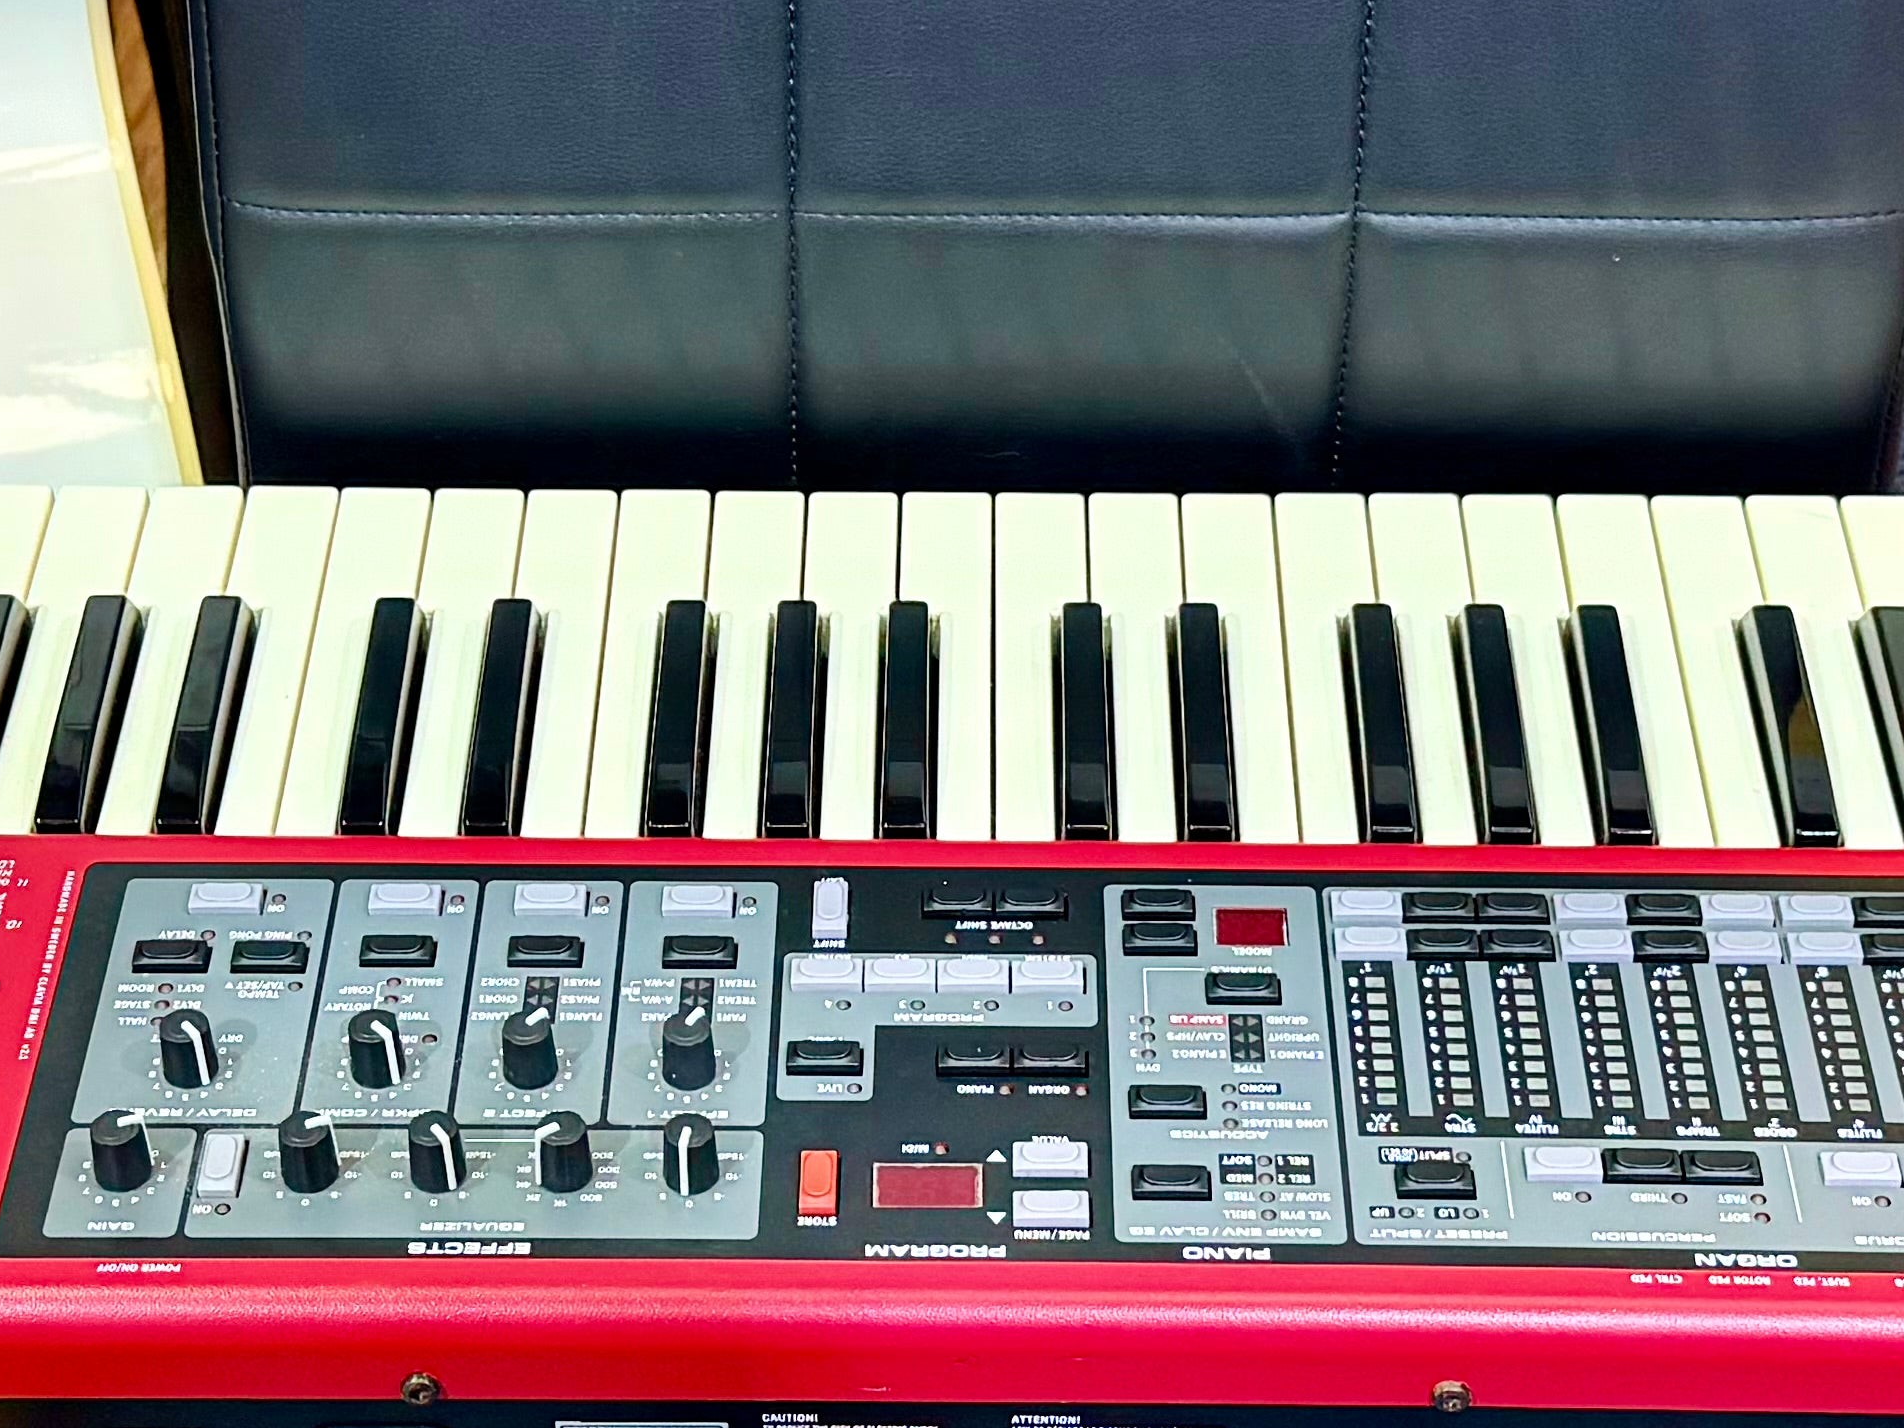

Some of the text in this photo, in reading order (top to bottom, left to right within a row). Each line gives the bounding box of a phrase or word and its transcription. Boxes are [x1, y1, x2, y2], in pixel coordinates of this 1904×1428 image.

[816, 1083, 843, 1094] LIVE
[796, 1215, 838, 1228] STORE
[407, 1240, 532, 1256] EFFECTS
[864, 1244, 1007, 1257] PROGRAM
[1182, 1246, 1271, 1260] PIANO
[1694, 1253, 1798, 1268] ORGAN
[141, 1263, 181, 1274] POWER
